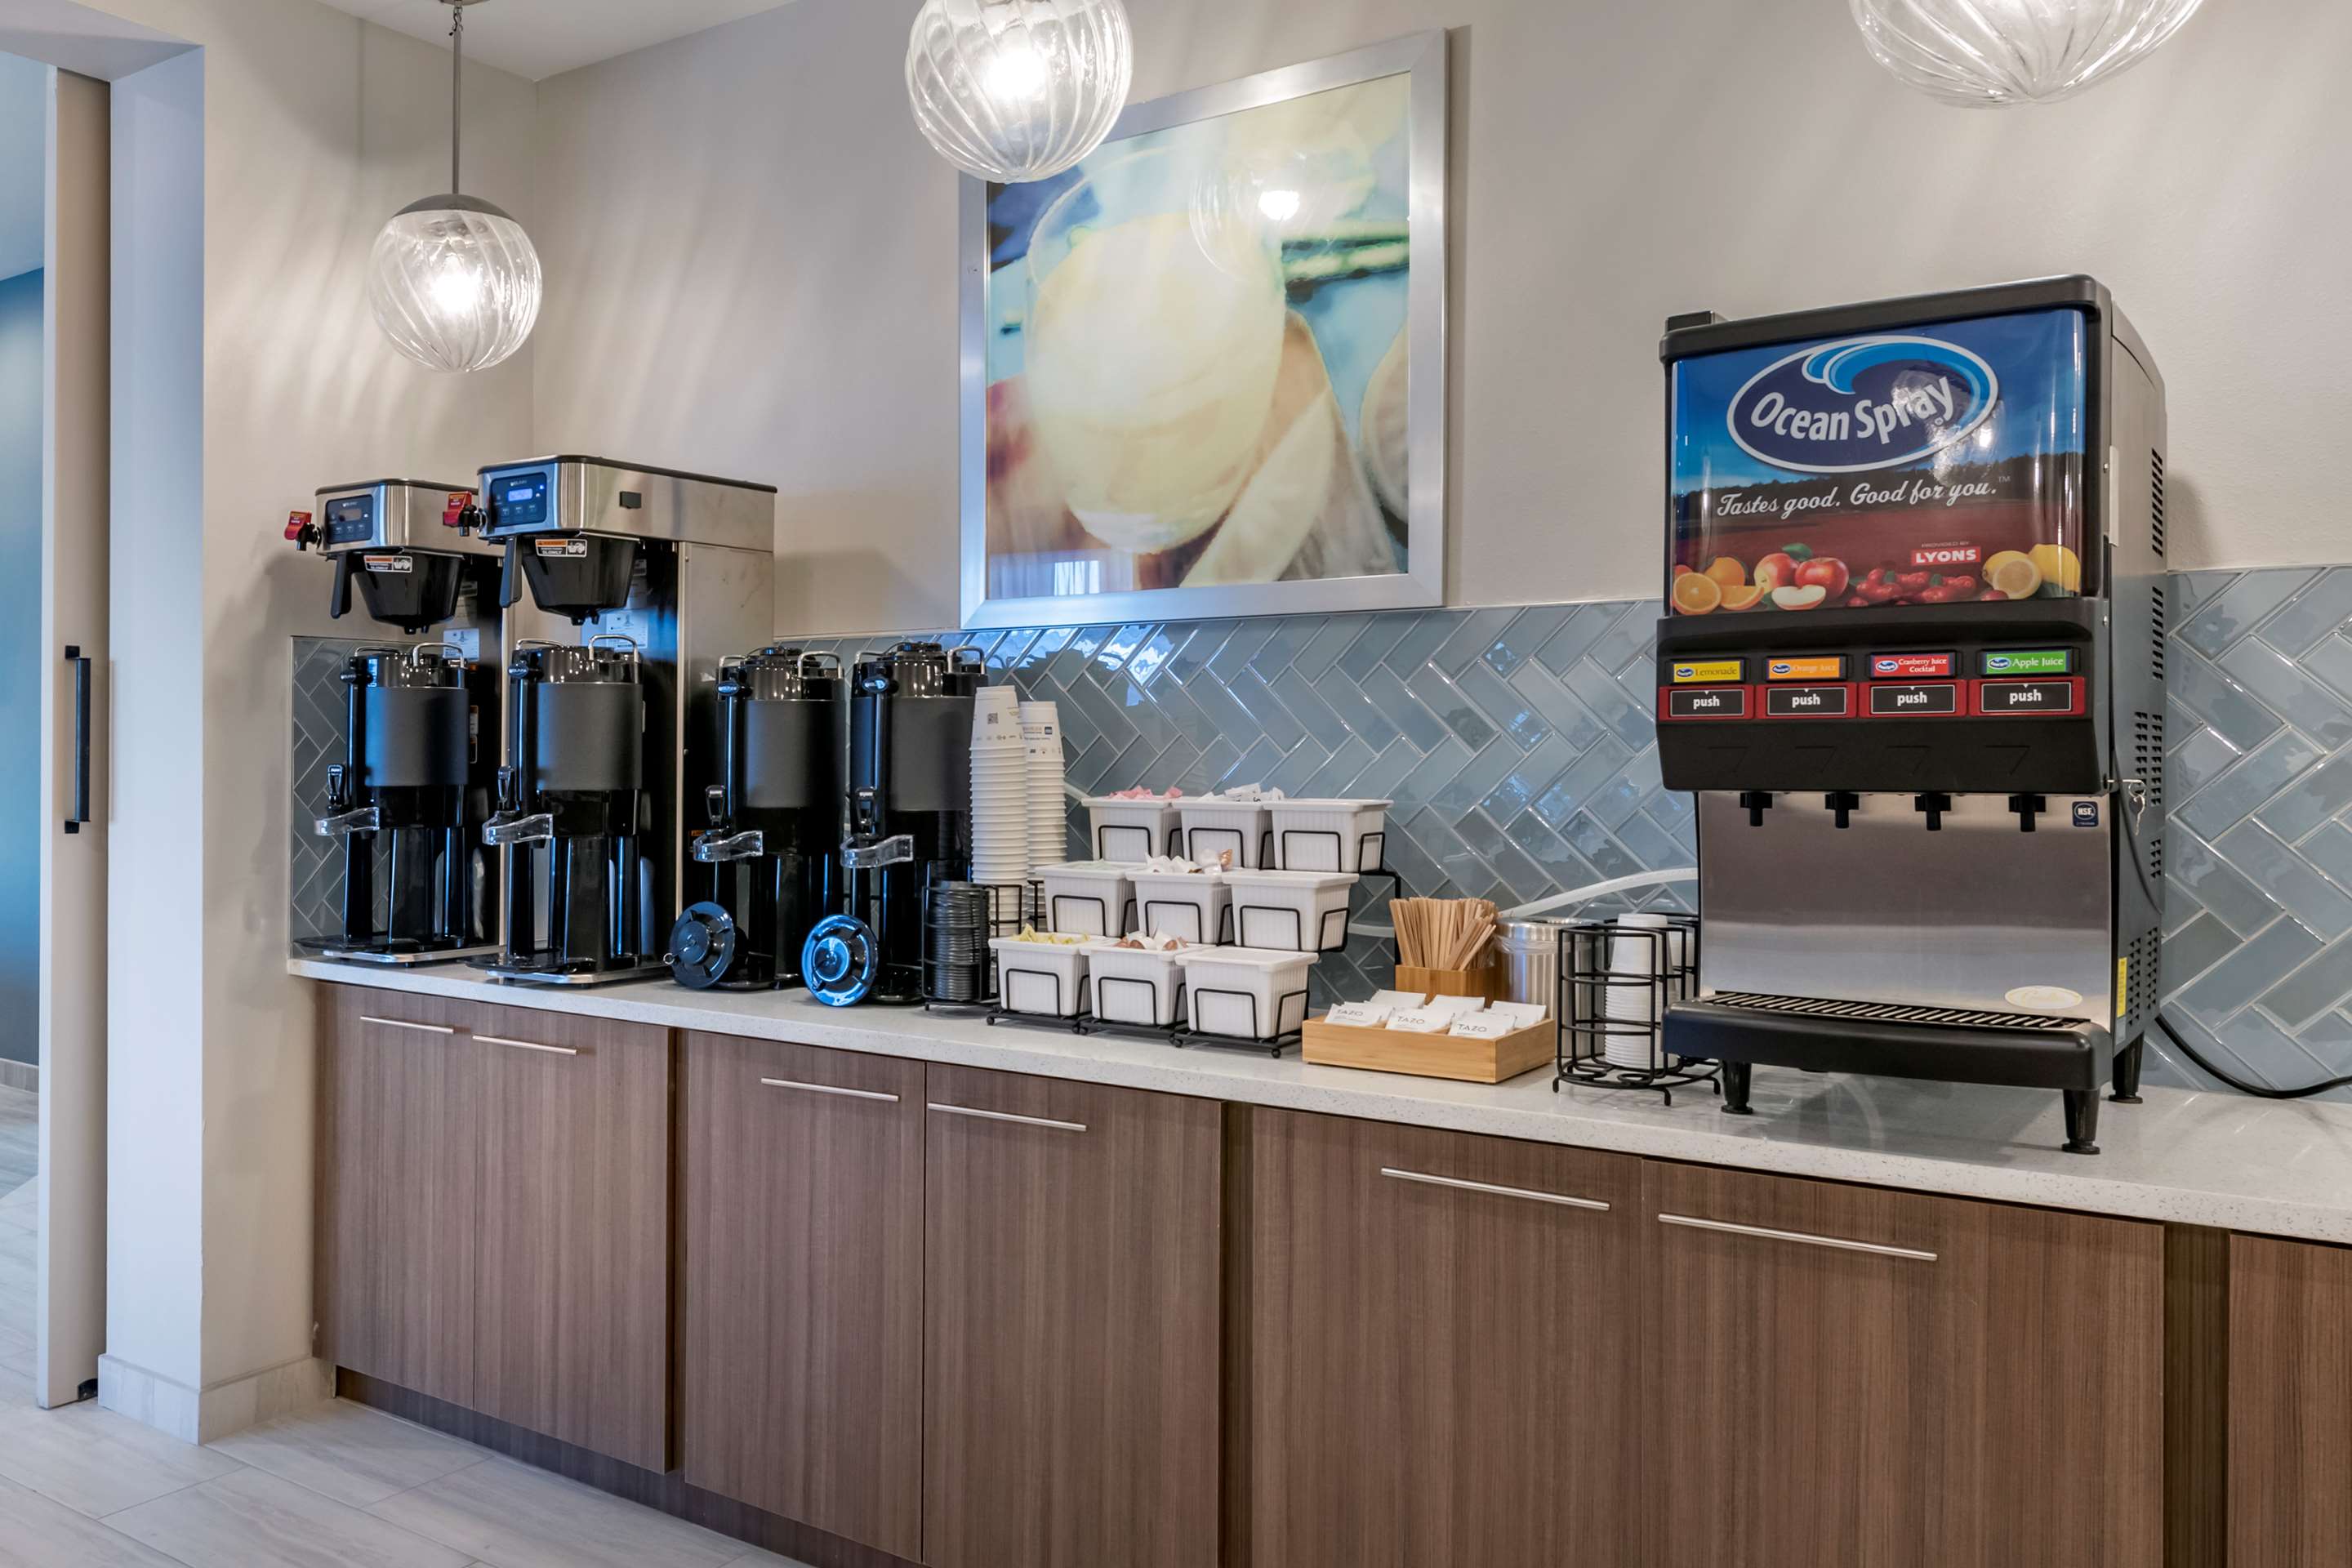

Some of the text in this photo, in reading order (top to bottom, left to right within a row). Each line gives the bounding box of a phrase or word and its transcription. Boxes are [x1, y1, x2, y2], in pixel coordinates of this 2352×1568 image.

[1751, 376, 1954, 444] Ocean Spray
[1717, 479, 1997, 519] Tastes good. Good for you.
[1915, 549, 1976, 563] LYONS
[1931, 657, 1948, 665] Juice
[2012, 658, 2039, 668] Apple
[2042, 657, 2064, 666] Juice
[1695, 666, 1737, 676] Lemonade
[1909, 665, 1936, 673] Cocktail
[1792, 693, 1821, 708] push
[1896, 691, 1927, 706] push
[2009, 689, 2042, 705] push
[1693, 696, 1721, 710] push
[2077, 807, 2092, 816] NSF
[1337, 1008, 1364, 1017] TAZO
[1397, 1015, 1425, 1025] TAZO
[1458, 1023, 1488, 1032] TAZO
